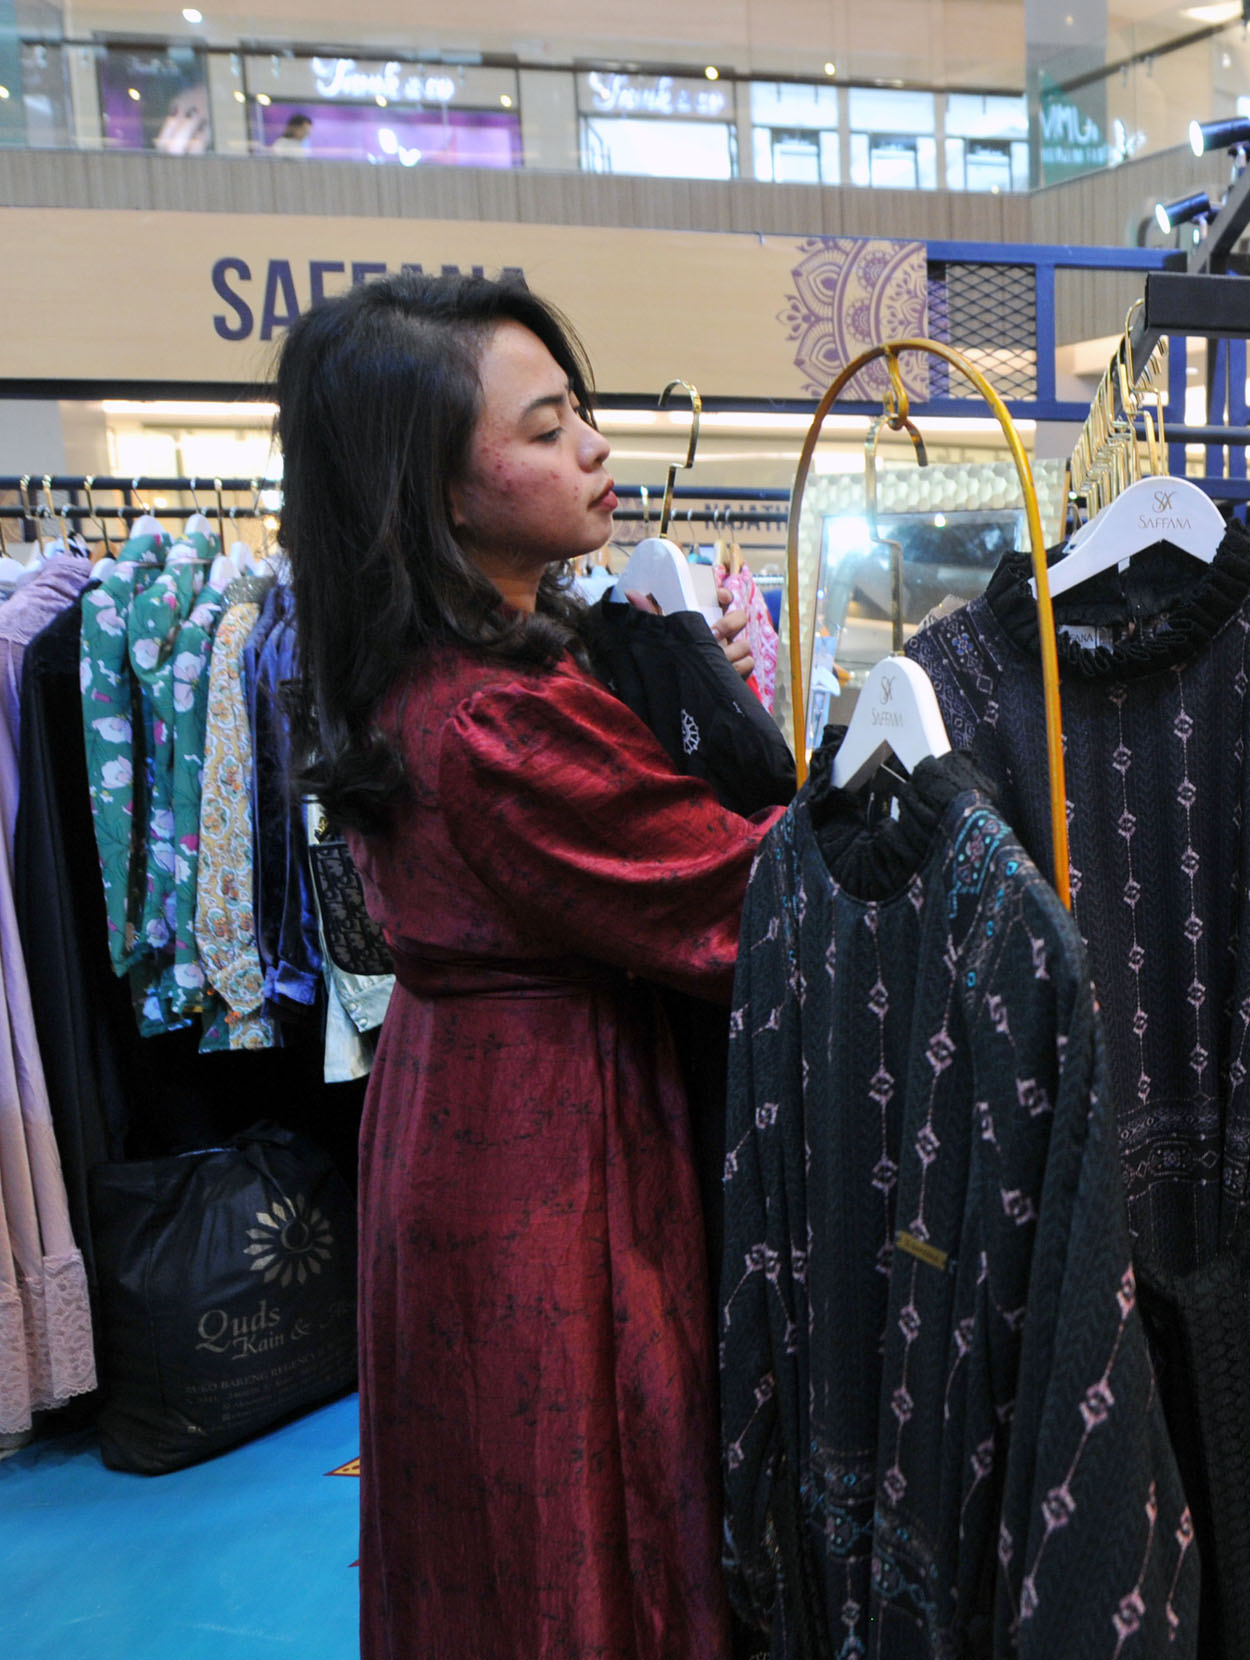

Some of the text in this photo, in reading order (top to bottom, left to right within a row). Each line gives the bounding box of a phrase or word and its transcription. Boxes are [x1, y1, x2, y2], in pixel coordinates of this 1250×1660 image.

[1138, 514, 1192, 529] SAFFANA
[195, 1299, 281, 1353] Quds
[232, 1331, 285, 1360] Kain
